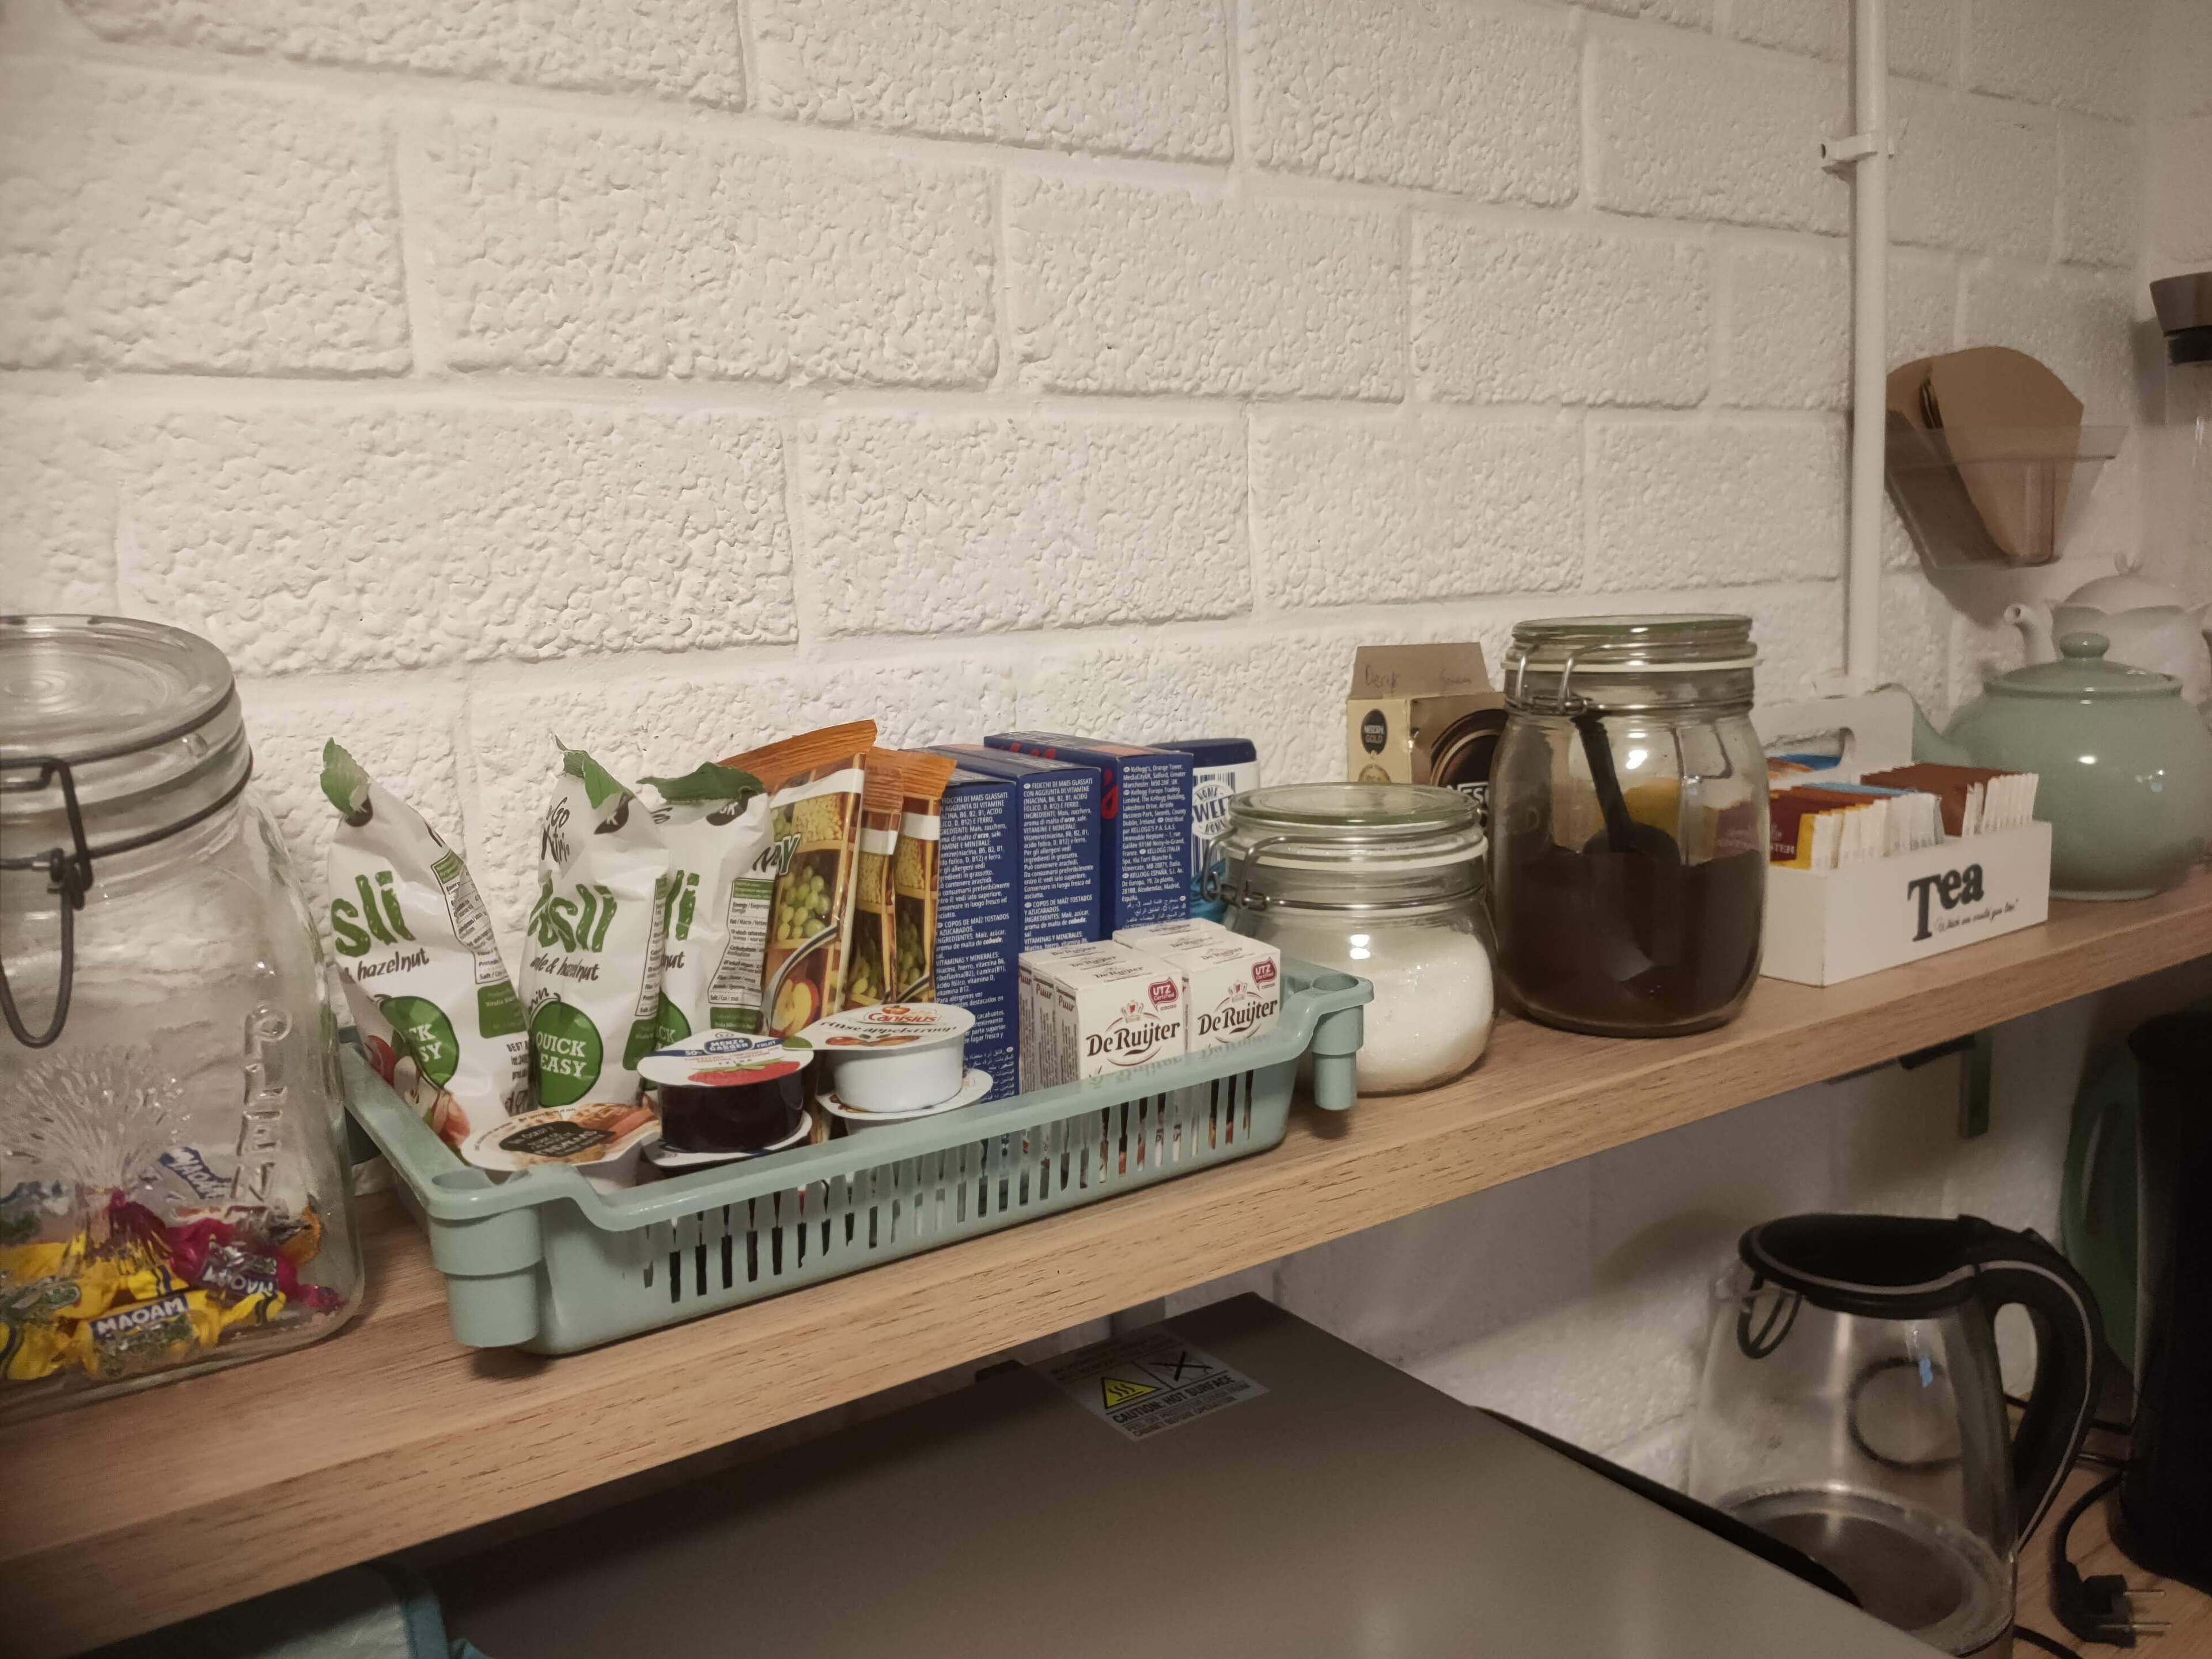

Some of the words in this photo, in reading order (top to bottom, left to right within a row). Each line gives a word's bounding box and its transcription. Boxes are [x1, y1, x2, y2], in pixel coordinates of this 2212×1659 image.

[1365, 734, 1383, 744] GOLD
[1907, 863, 1984, 942] Tea
[358, 948, 430, 982] hazelnut
[556, 957, 599, 982] hazelnut
[1255, 964, 1271, 975] UTZ
[1036, 984, 1053, 1000] Puur
[1153, 984, 1171, 995] UTZ
[1058, 995, 1075, 1012] Puur
[868, 1013, 938, 1023] Canisius
[1198, 1014, 1221, 1035] De
[1222, 1000, 1278, 1031] Ruijter
[506, 1041, 524, 1052] BEST
[536, 1031, 586, 1058] QUICK
[709, 1043, 748, 1052] GASSER
[756, 1040, 777, 1048] FRUIT
[1086, 1034, 1113, 1056] De
[1114, 1022, 1180, 1054] Ruijter
[540, 1053, 587, 1077] EASY
[96, 1297, 187, 1334] MAOAM
[1163, 1390, 1188, 1406] HOT
[1188, 1374, 1236, 1397] SURFACE
